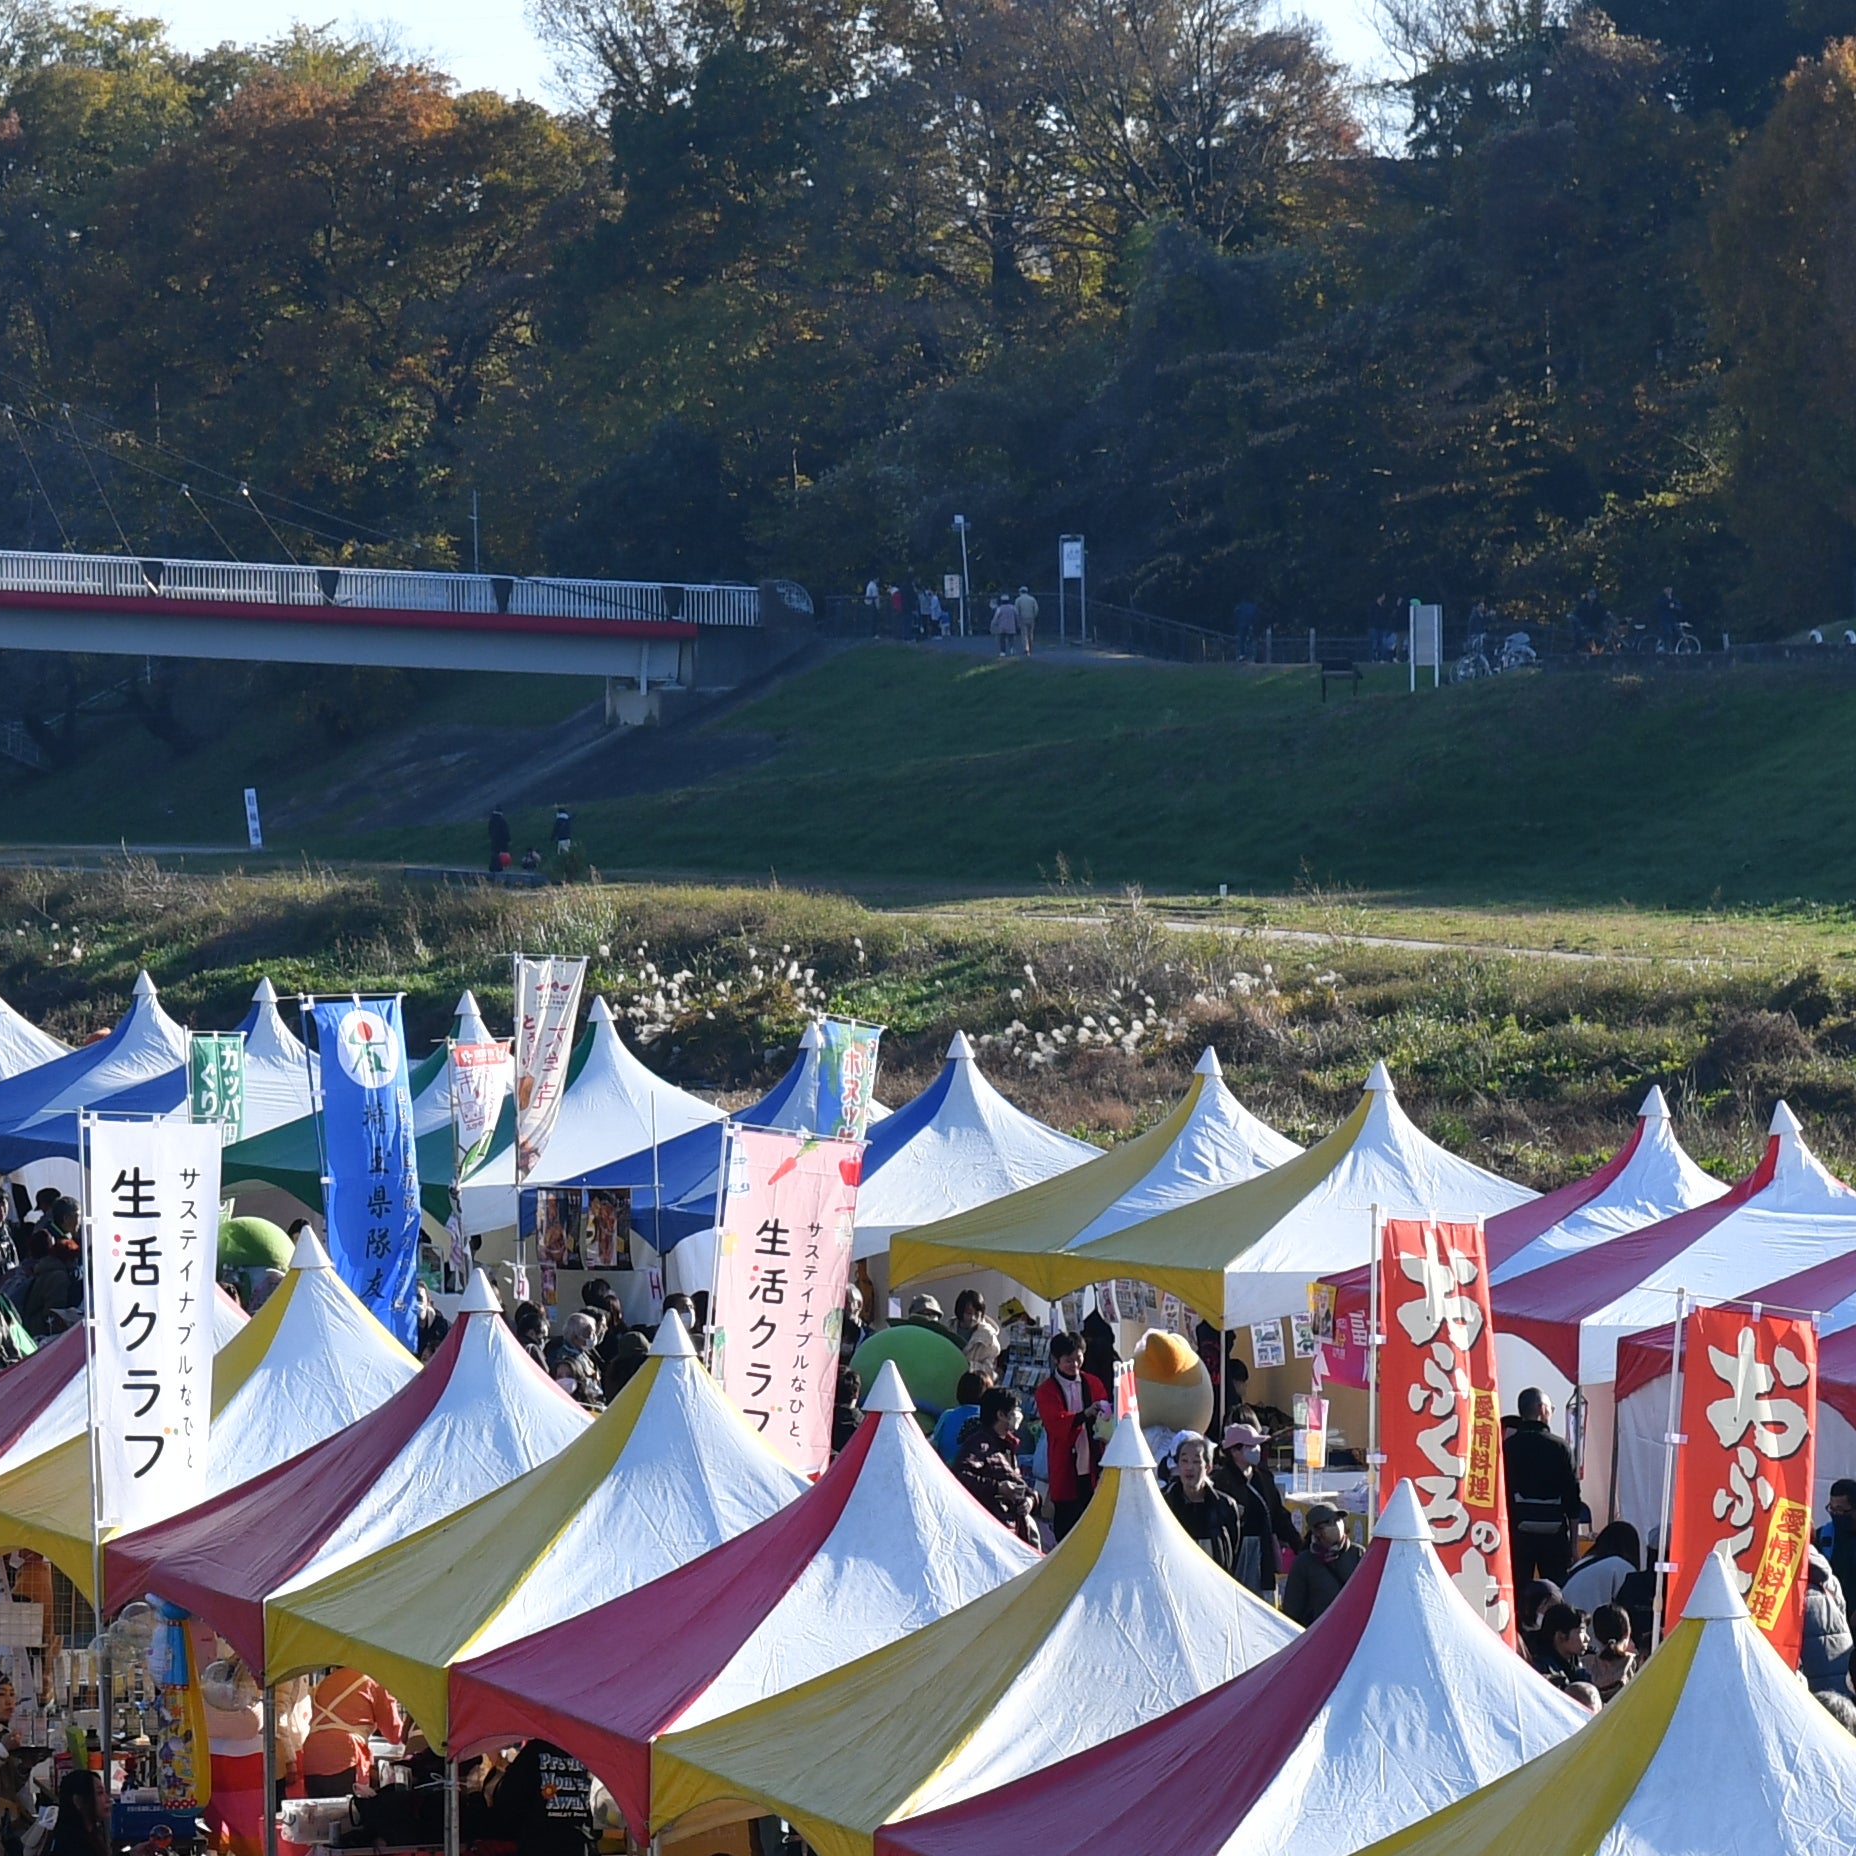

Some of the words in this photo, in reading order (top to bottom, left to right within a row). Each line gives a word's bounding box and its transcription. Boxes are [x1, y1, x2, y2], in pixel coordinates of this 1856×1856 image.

[110, 1165, 180, 1480] 生活クラブ
[742, 1218, 792, 1433] 生活クラブ
[788, 1222, 824, 1449] サステイナブルなひと、
[1471, 1395, 1495, 1501] 愛情料理
[1750, 1507, 1807, 1622] 愛情料理
